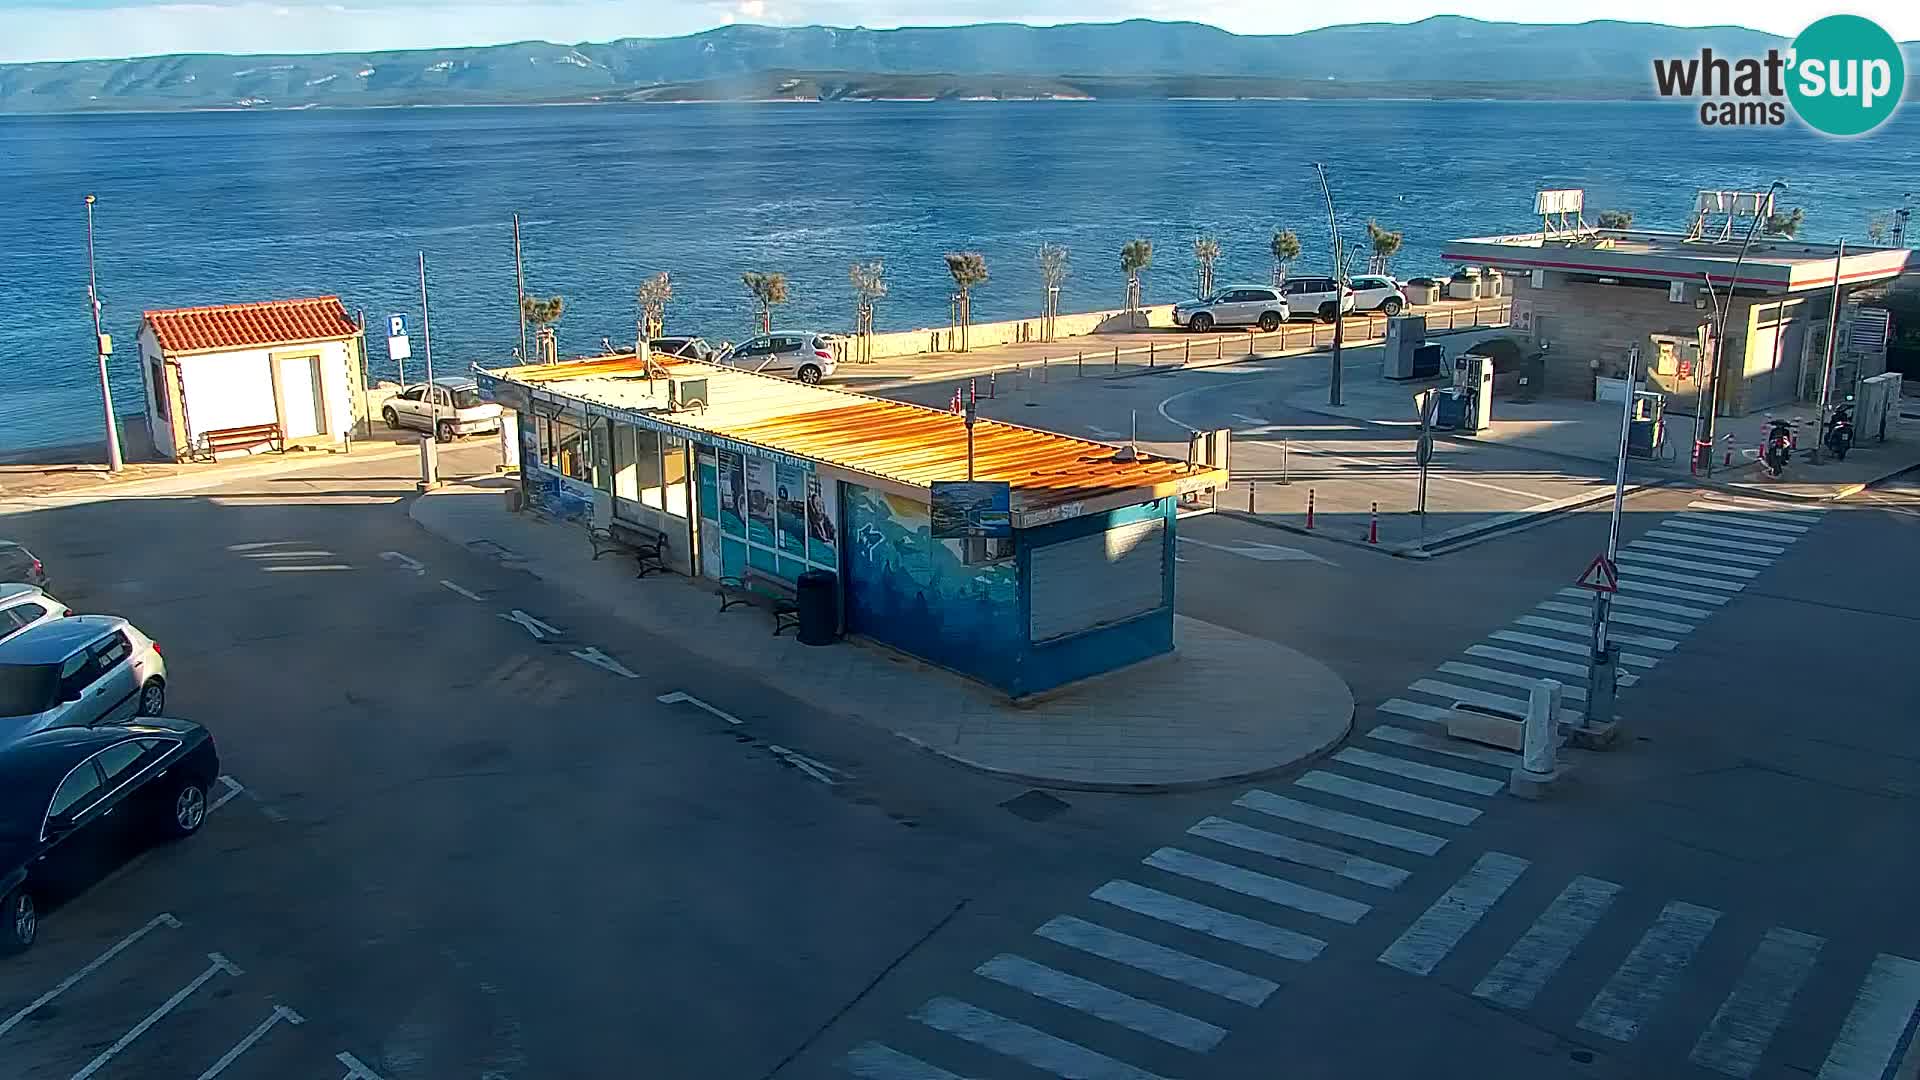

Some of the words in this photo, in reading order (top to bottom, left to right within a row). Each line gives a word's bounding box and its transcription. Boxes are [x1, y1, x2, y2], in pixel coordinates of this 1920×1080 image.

[391, 316, 403, 335] P
[672, 425, 702, 442] POSTAJA
[711, 436, 726, 448] BUS
[726, 440, 757, 456] STATION
[759, 449, 784, 463] TICKET
[785, 455, 812, 470] OFFICE
